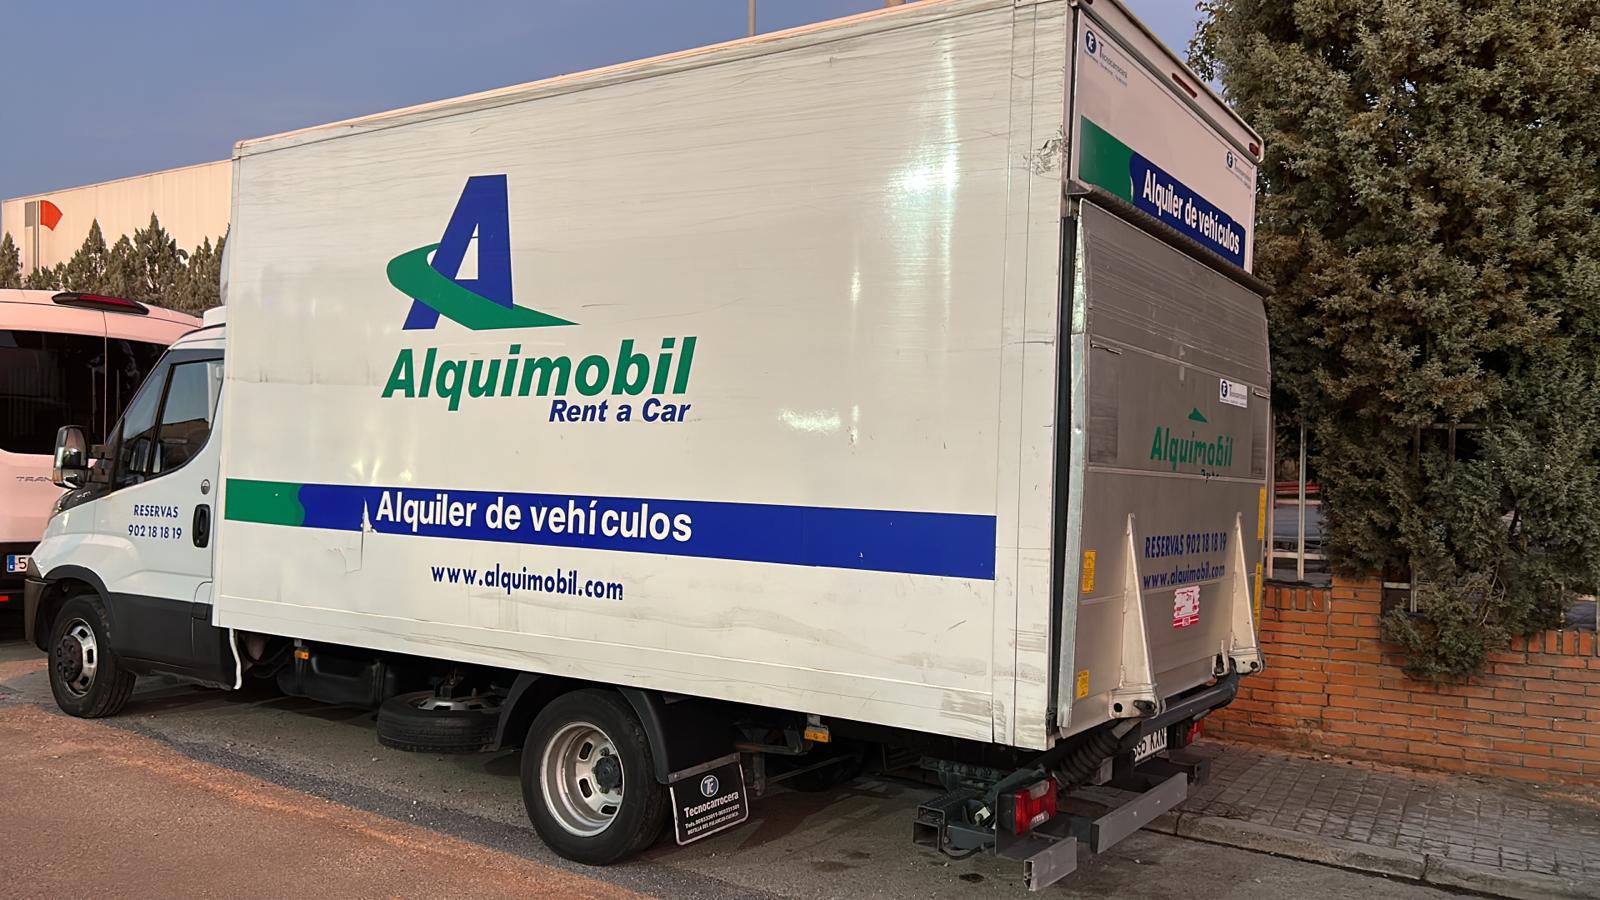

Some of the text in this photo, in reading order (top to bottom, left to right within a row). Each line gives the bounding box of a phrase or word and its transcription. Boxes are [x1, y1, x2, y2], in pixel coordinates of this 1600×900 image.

[1143, 169, 1183, 220] Alquiler
[1185, 197, 1197, 229] de
[1199, 211, 1240, 255] vehículos
[381, 336, 697, 411] Alquimobil
[549, 398, 691, 422] Rent a Car
[1150, 426, 1233, 472] Alquimobil
[134, 504, 178, 518] RESERVAS
[376, 491, 692, 542] Alquiler de vehículos
[128, 524, 182, 540] 902 18 18 19
[1145, 531, 1227, 558] RESERVAS 902 18 18 19
[431, 563, 624, 600] www.alquimobil.com
[684, 791, 739, 818] Tecnocarrocera
